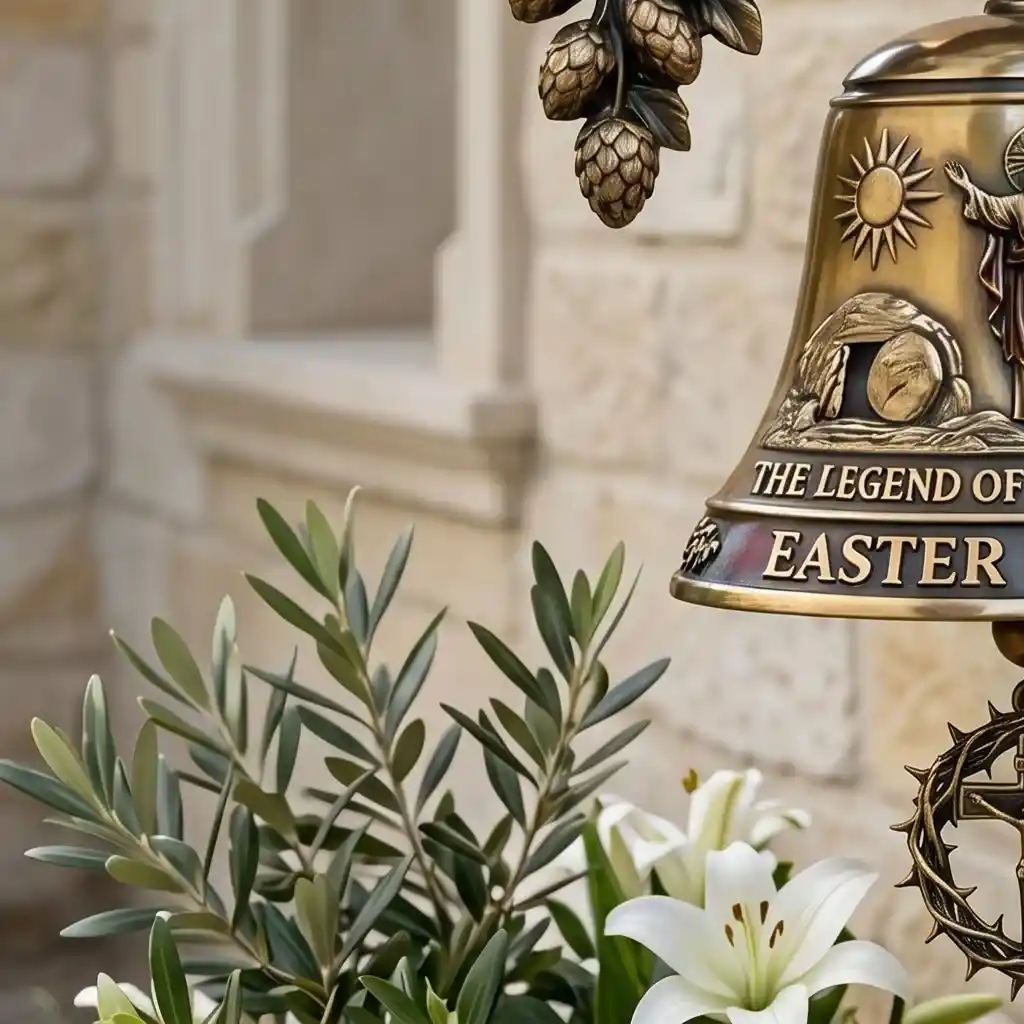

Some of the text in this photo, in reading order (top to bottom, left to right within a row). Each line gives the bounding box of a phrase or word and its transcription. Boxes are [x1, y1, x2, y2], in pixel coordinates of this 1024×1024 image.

[751, 461, 811, 497] THE
[813, 464, 961, 502] LEGEND
[972, 468, 1024, 503] OF
[762, 529, 1007, 587] EASTER
